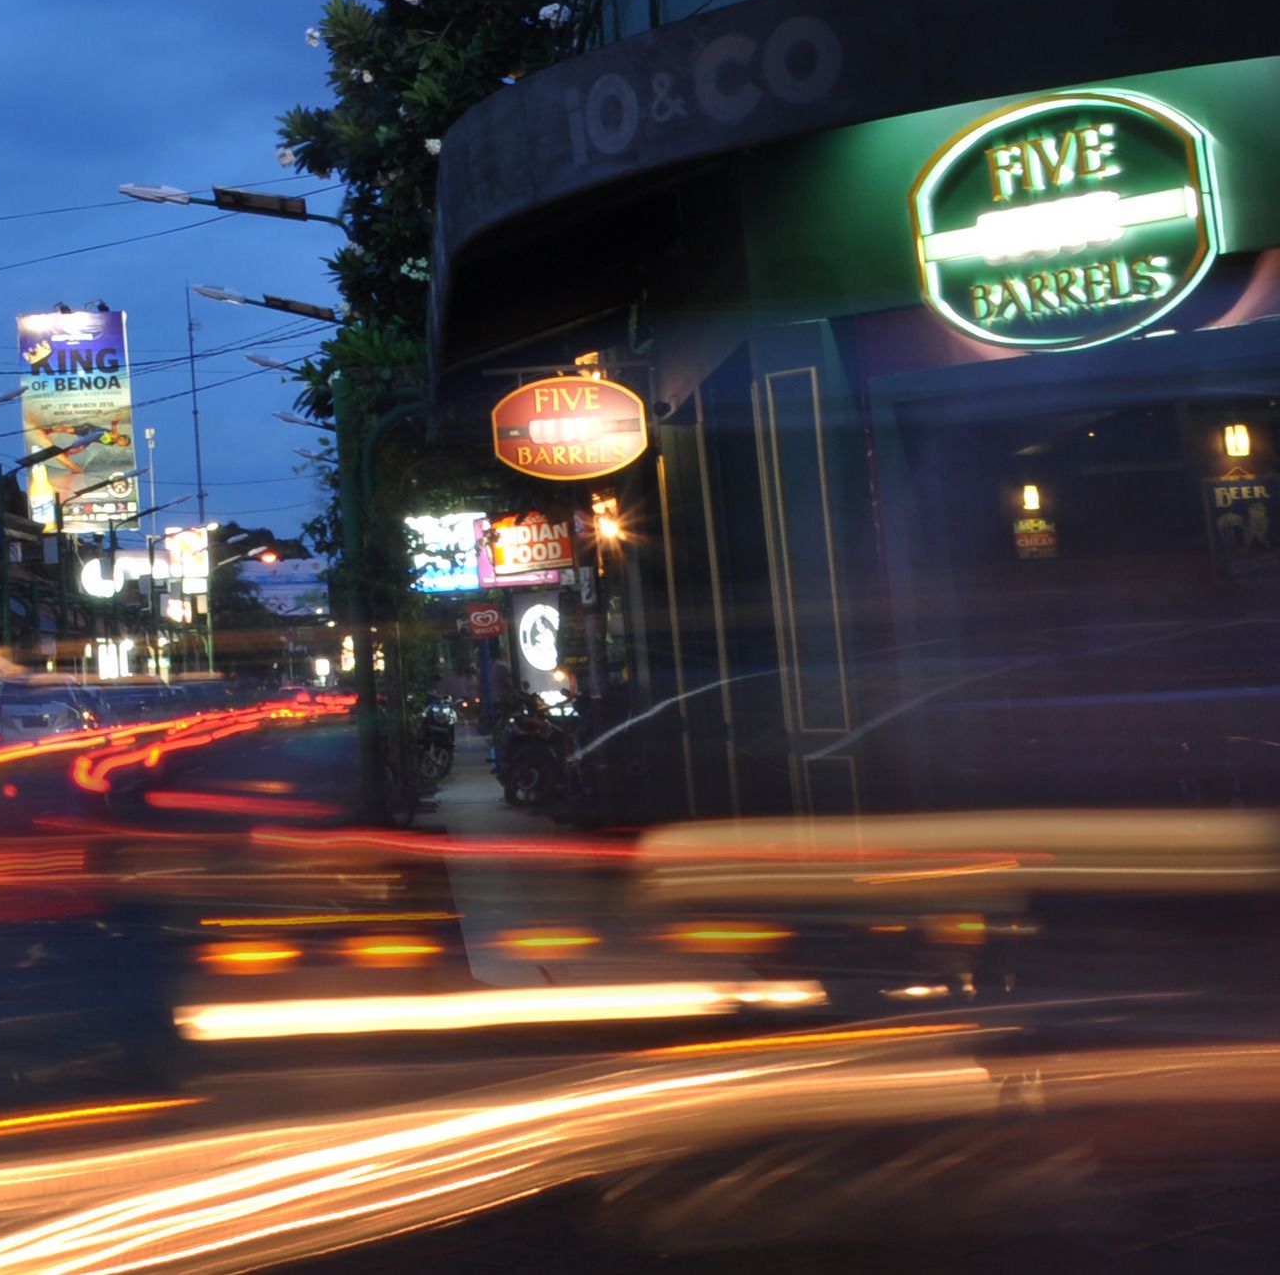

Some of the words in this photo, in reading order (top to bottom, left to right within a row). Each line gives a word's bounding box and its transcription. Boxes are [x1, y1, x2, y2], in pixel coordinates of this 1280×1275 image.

[985, 123, 1122, 202] FIVE
[969, 255, 1175, 323] BARRELS
[31, 347, 120, 375] KING
[32, 380, 49, 391] OF
[54, 376, 121, 392] BENOA
[534, 387, 601, 413] FIVE
[517, 444, 627, 465] BARRELS
[1214, 485, 1271, 509] BEER
[504, 542, 562, 564] FOOD
